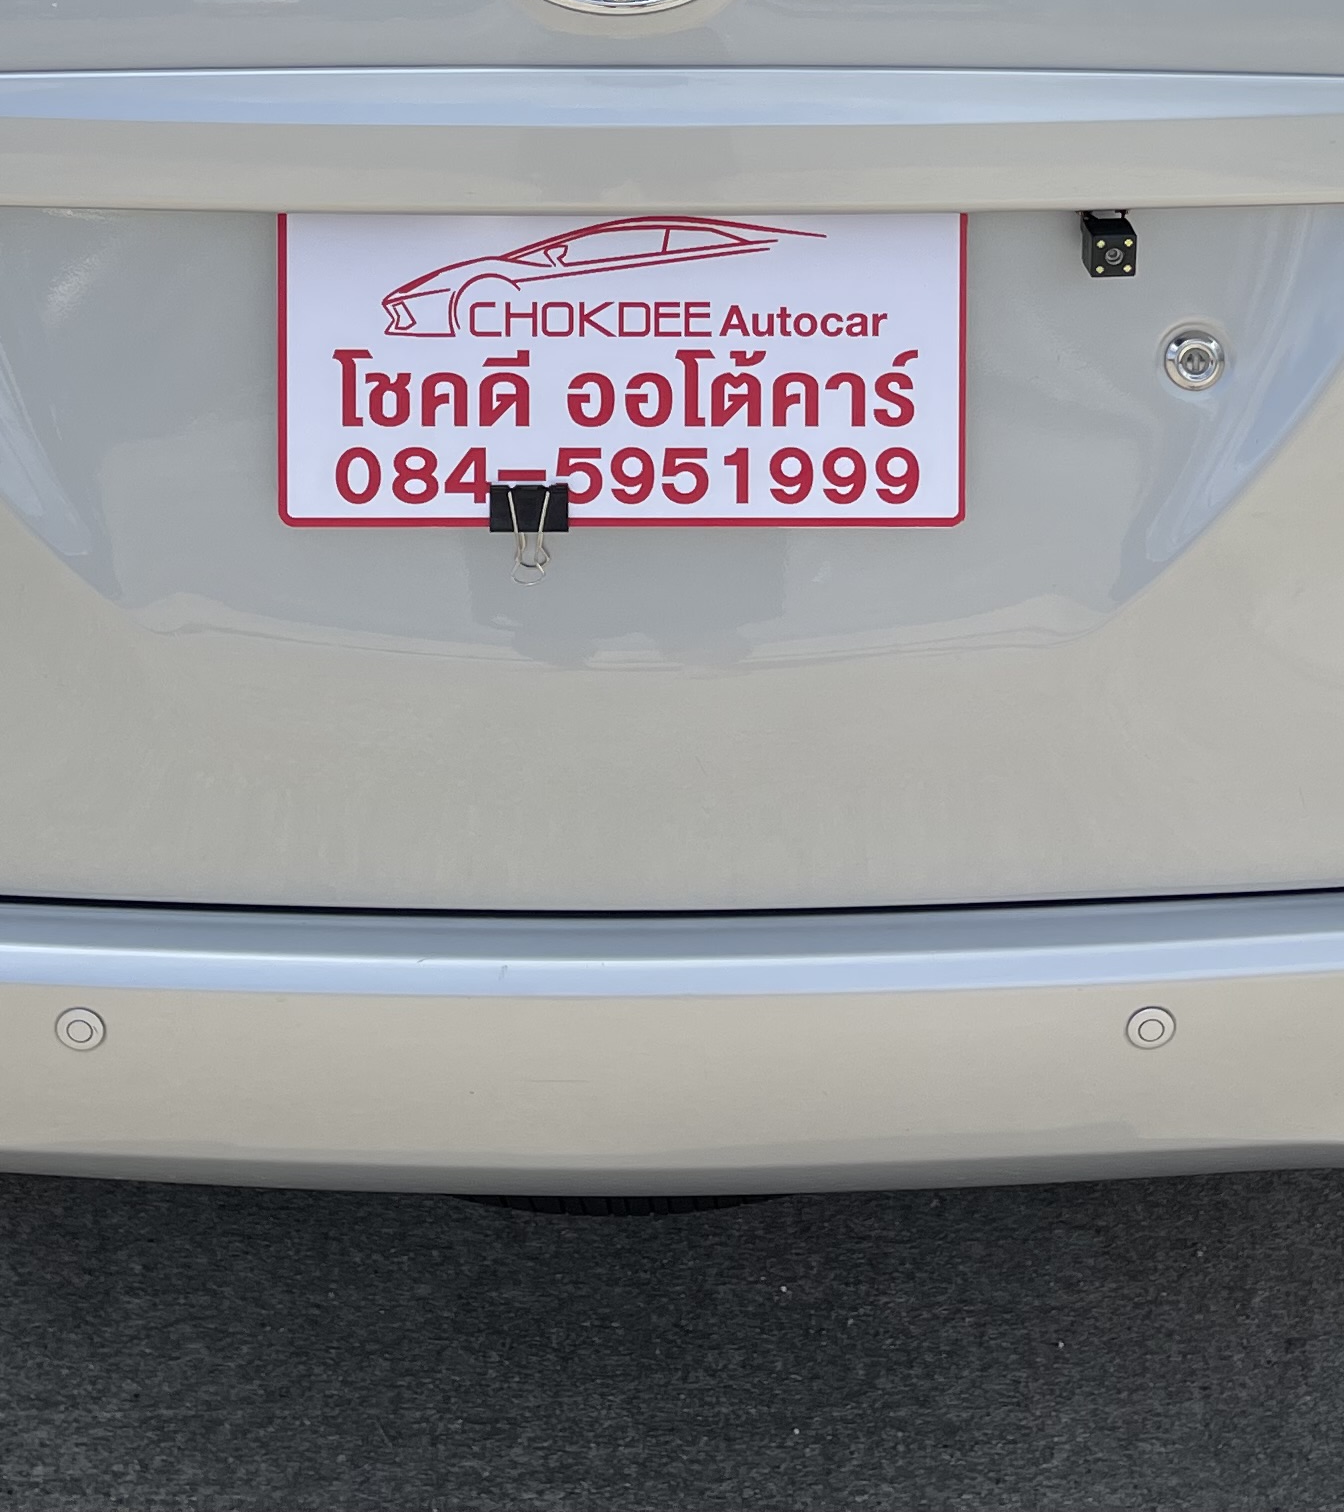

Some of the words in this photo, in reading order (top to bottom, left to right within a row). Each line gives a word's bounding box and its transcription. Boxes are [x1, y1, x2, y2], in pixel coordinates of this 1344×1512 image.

[467, 300, 713, 338] CHOKDEE
[719, 303, 889, 338] Autocar
[331, 349, 532, 428] โชคดี
[565, 348, 920, 428] ออโต้คาร์
[334, 446, 921, 506] 084-5951999
